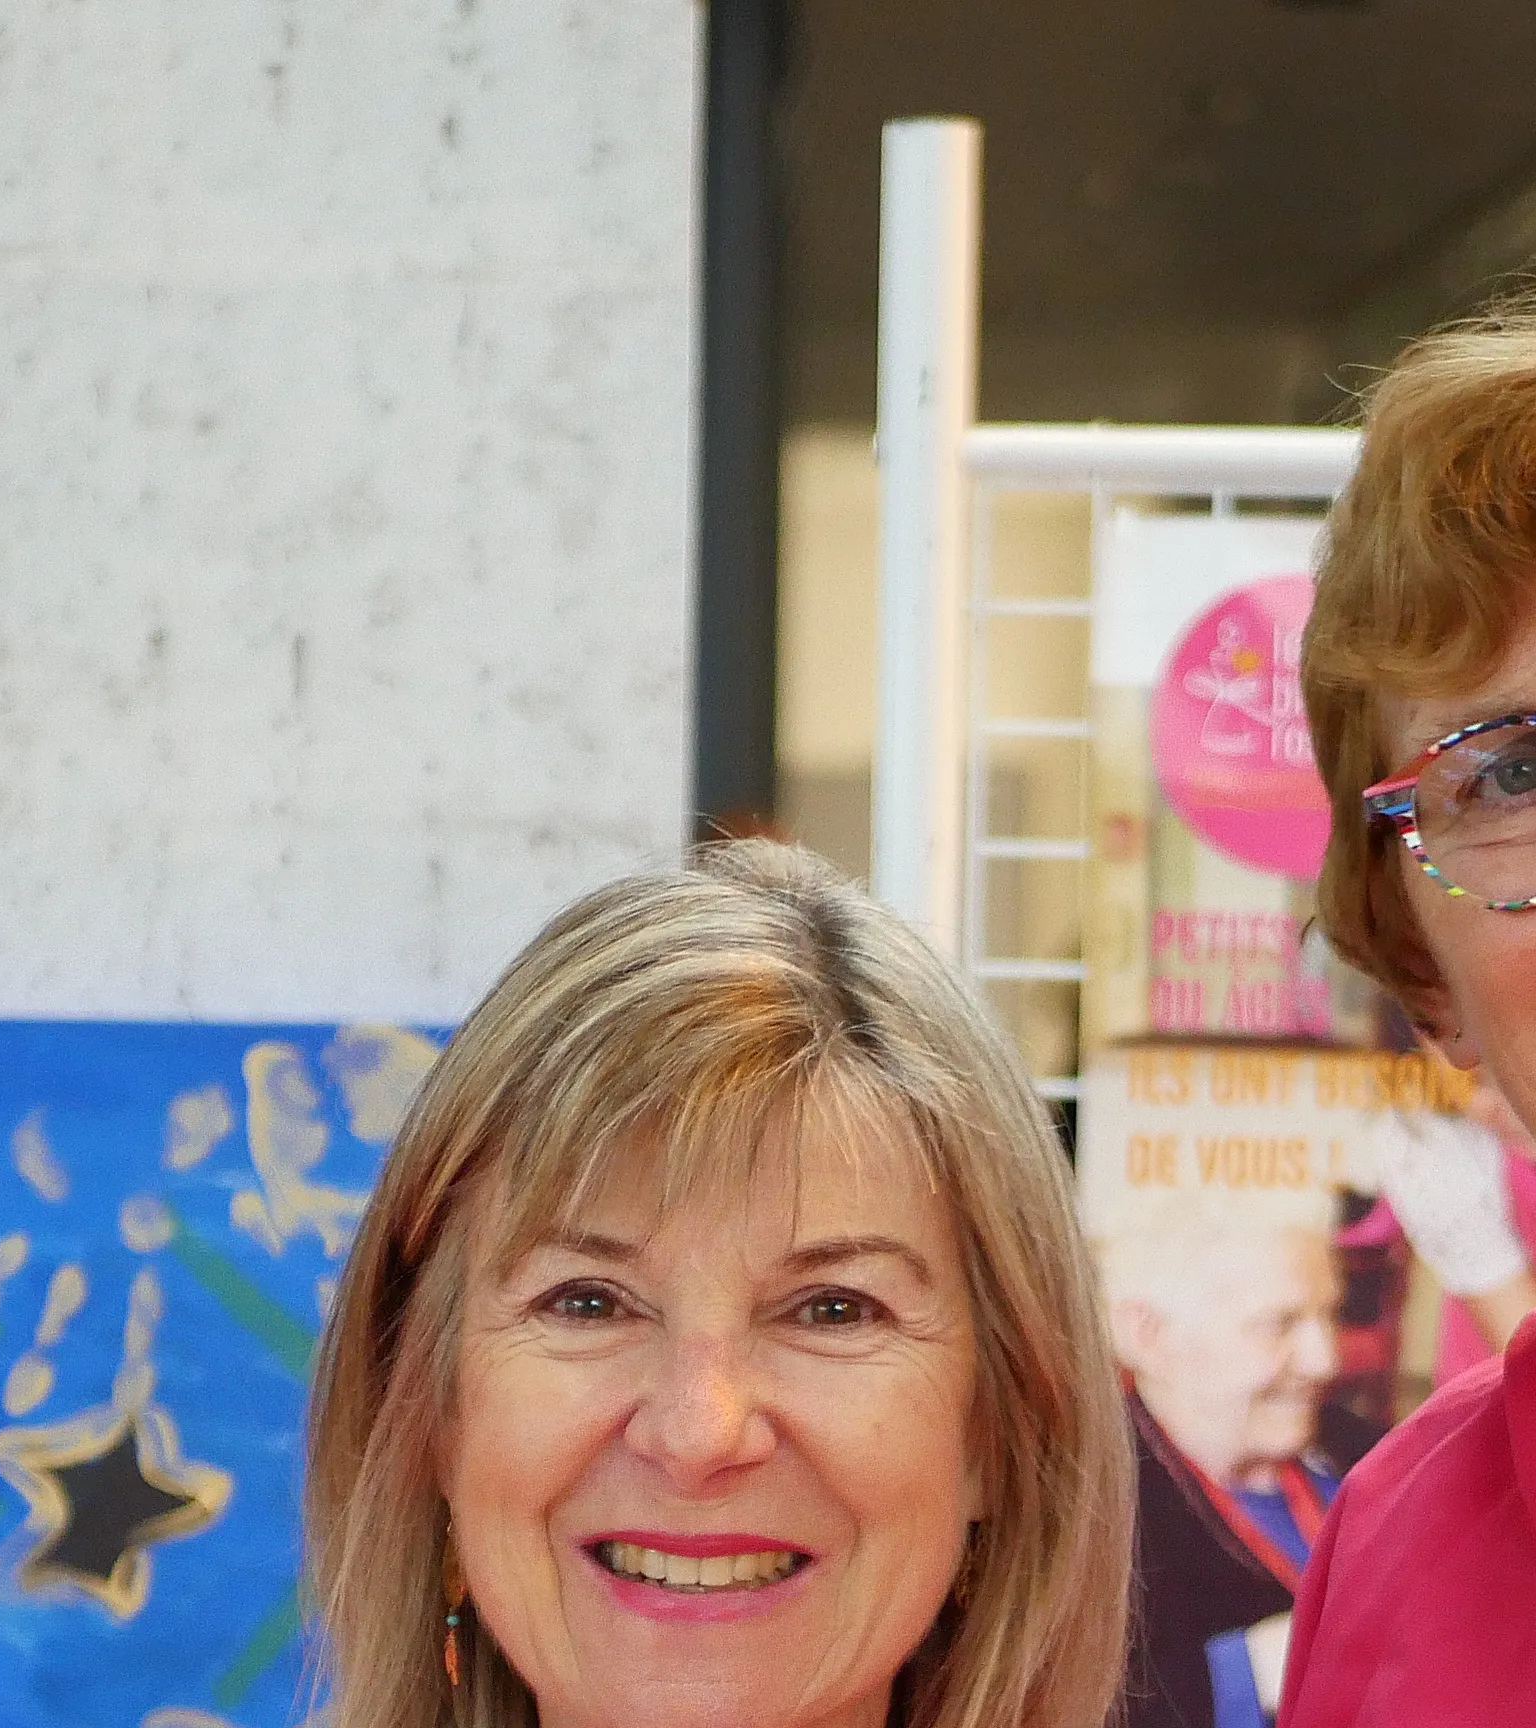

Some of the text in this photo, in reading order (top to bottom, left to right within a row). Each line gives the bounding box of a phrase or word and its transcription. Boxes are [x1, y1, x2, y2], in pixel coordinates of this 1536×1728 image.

[1152, 909, 1297, 963] PETITS
[1149, 975, 1204, 1033] OU
[1127, 1047, 1192, 1106] ILS
[1211, 1047, 1296, 1107] ONT
[1126, 1132, 1179, 1188] DE
[1196, 1133, 1310, 1190] VOUS
